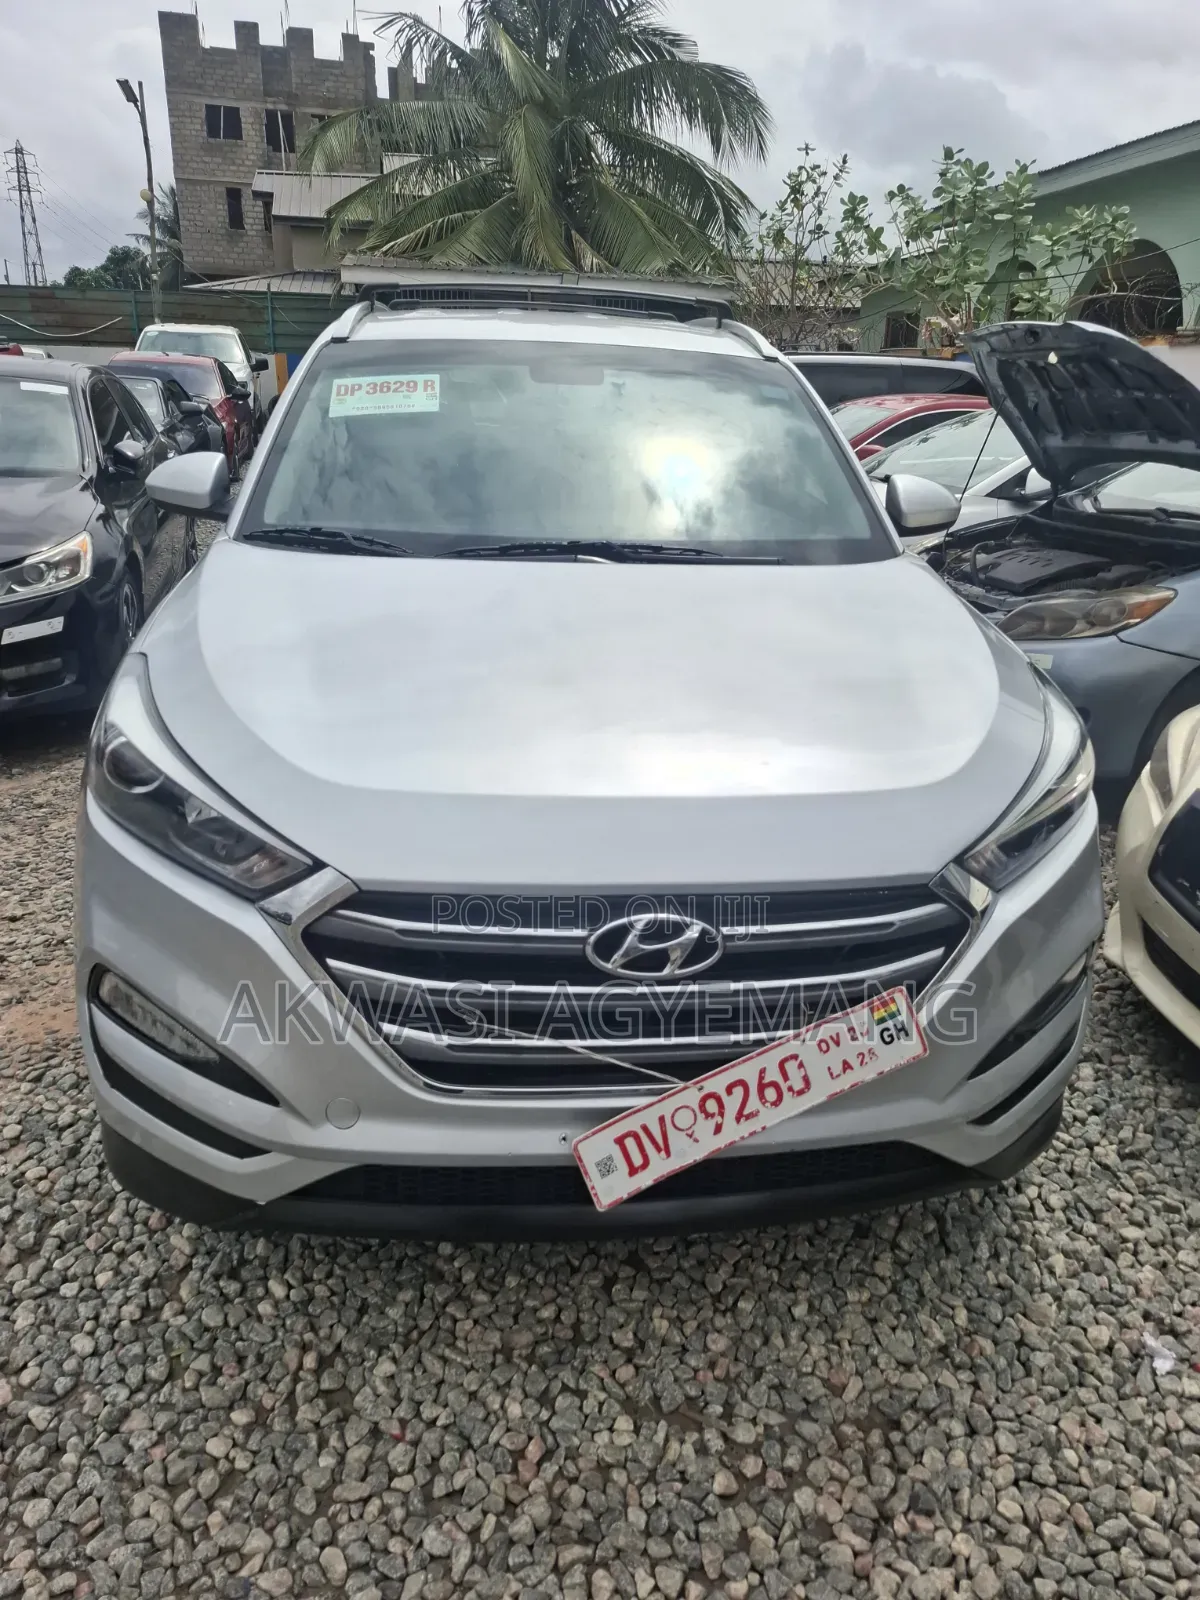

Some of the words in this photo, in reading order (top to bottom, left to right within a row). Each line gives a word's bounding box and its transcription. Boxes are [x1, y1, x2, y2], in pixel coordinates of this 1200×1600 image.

[335, 383, 363, 398] DP
[365, 379, 419, 396] 3629
[422, 379, 436, 393] R
[816, 1031, 841, 1055] DV
[879, 1019, 910, 1046] GH
[827, 1058, 855, 1080] LA
[613, 1114, 672, 1178] DV
[698, 1053, 812, 1136] 9260
